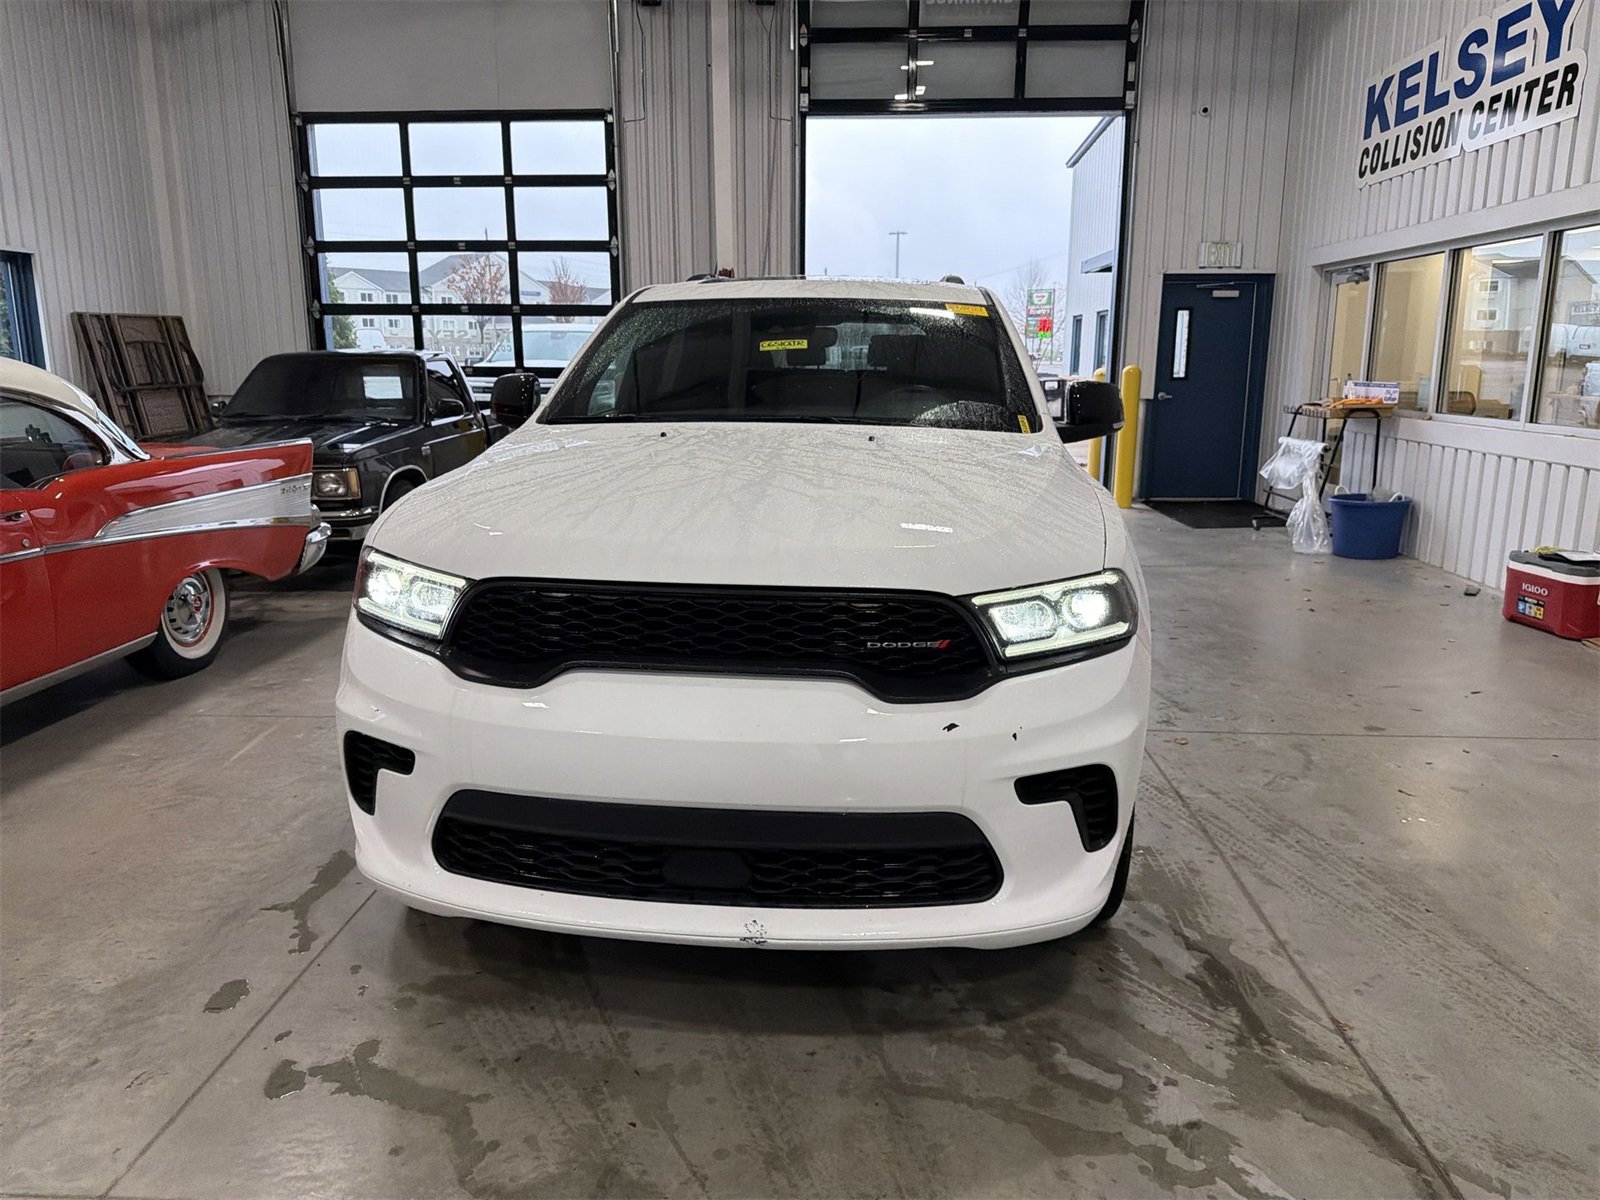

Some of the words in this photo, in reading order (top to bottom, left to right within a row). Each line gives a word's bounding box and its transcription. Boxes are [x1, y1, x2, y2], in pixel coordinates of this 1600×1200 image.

[1363, 0, 1574, 140] KELSEY
[1358, 108, 1463, 179] COLLISION
[1468, 62, 1580, 140] CENTER
[1207, 244, 1233, 267] EXIT
[1521, 582, 1549, 596] IGLOO
[866, 641, 939, 649] DODGE
